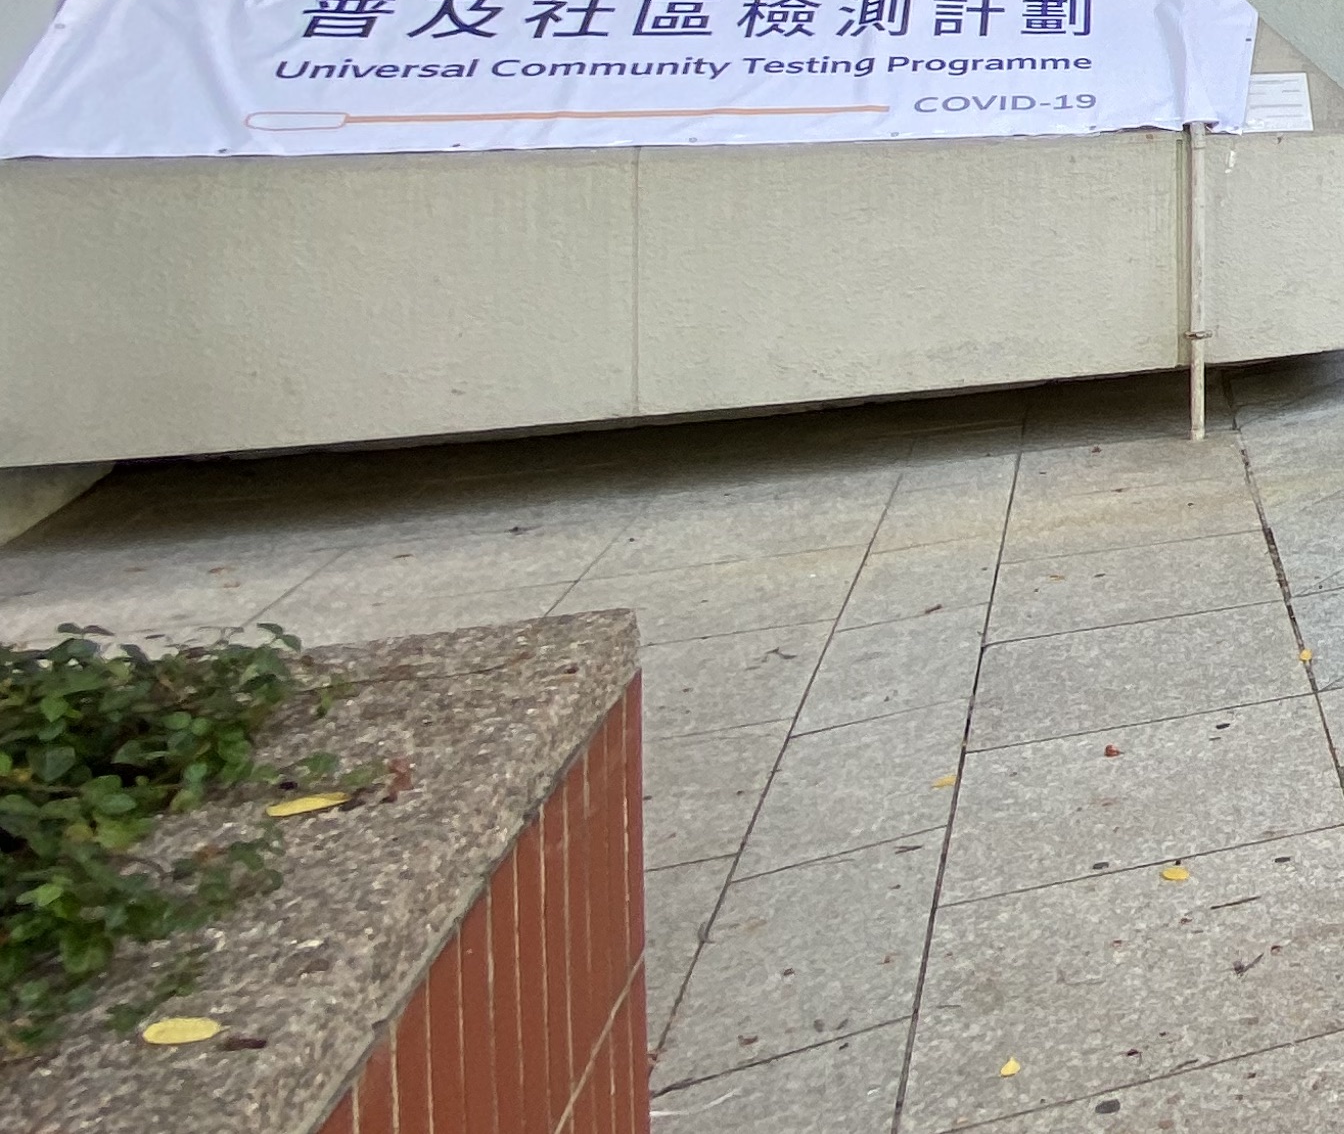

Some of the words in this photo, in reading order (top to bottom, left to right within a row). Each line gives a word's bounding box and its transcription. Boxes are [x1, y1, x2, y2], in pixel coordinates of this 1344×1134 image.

[273, 56, 480, 81] Universal
[490, 55, 732, 79] Community
[746, 56, 875, 78] Testing
[887, 53, 1094, 77] Programme
[913, 92, 1098, 113] COVID-19
